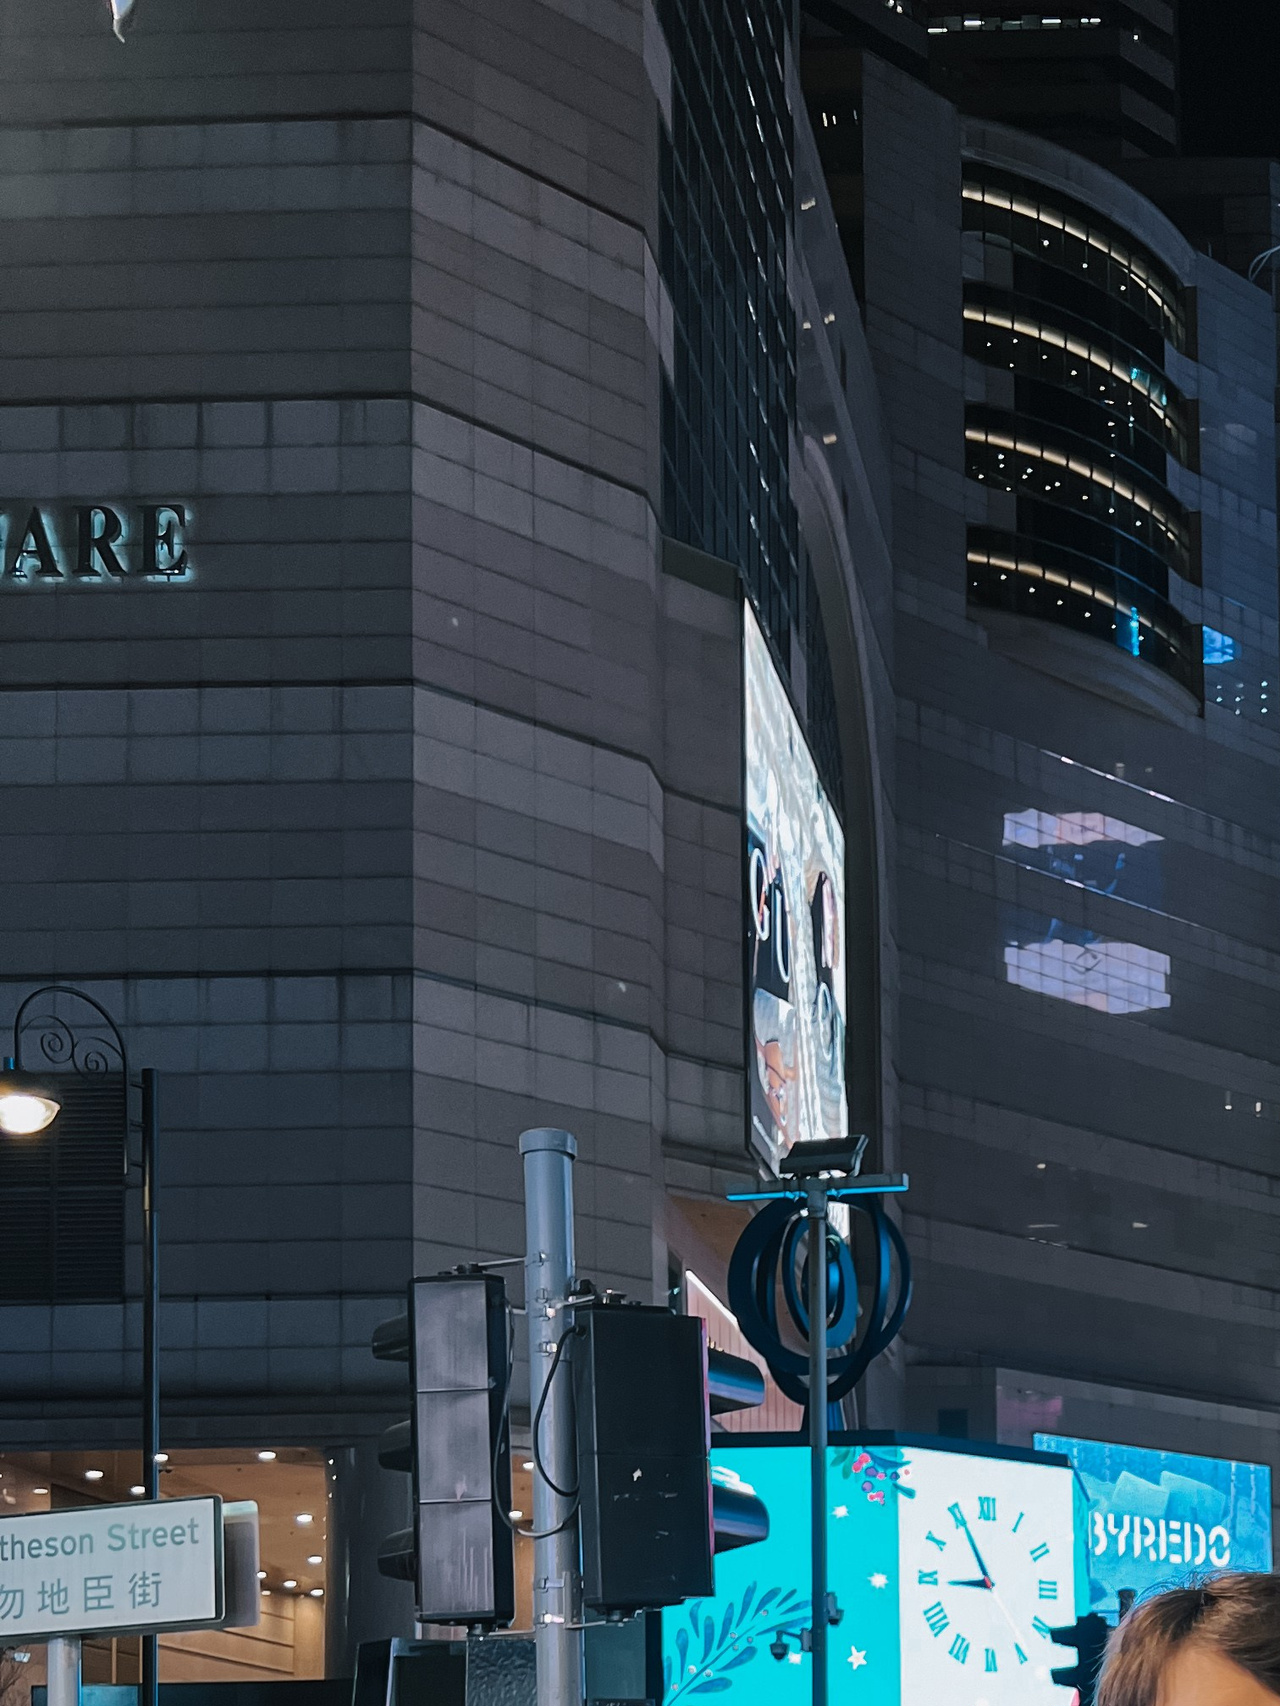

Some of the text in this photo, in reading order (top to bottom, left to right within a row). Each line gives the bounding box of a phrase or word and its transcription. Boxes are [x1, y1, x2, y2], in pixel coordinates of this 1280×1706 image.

[0, 1517, 200, 1561] theson Street
[1088, 1511, 1230, 1567] BYREDO
